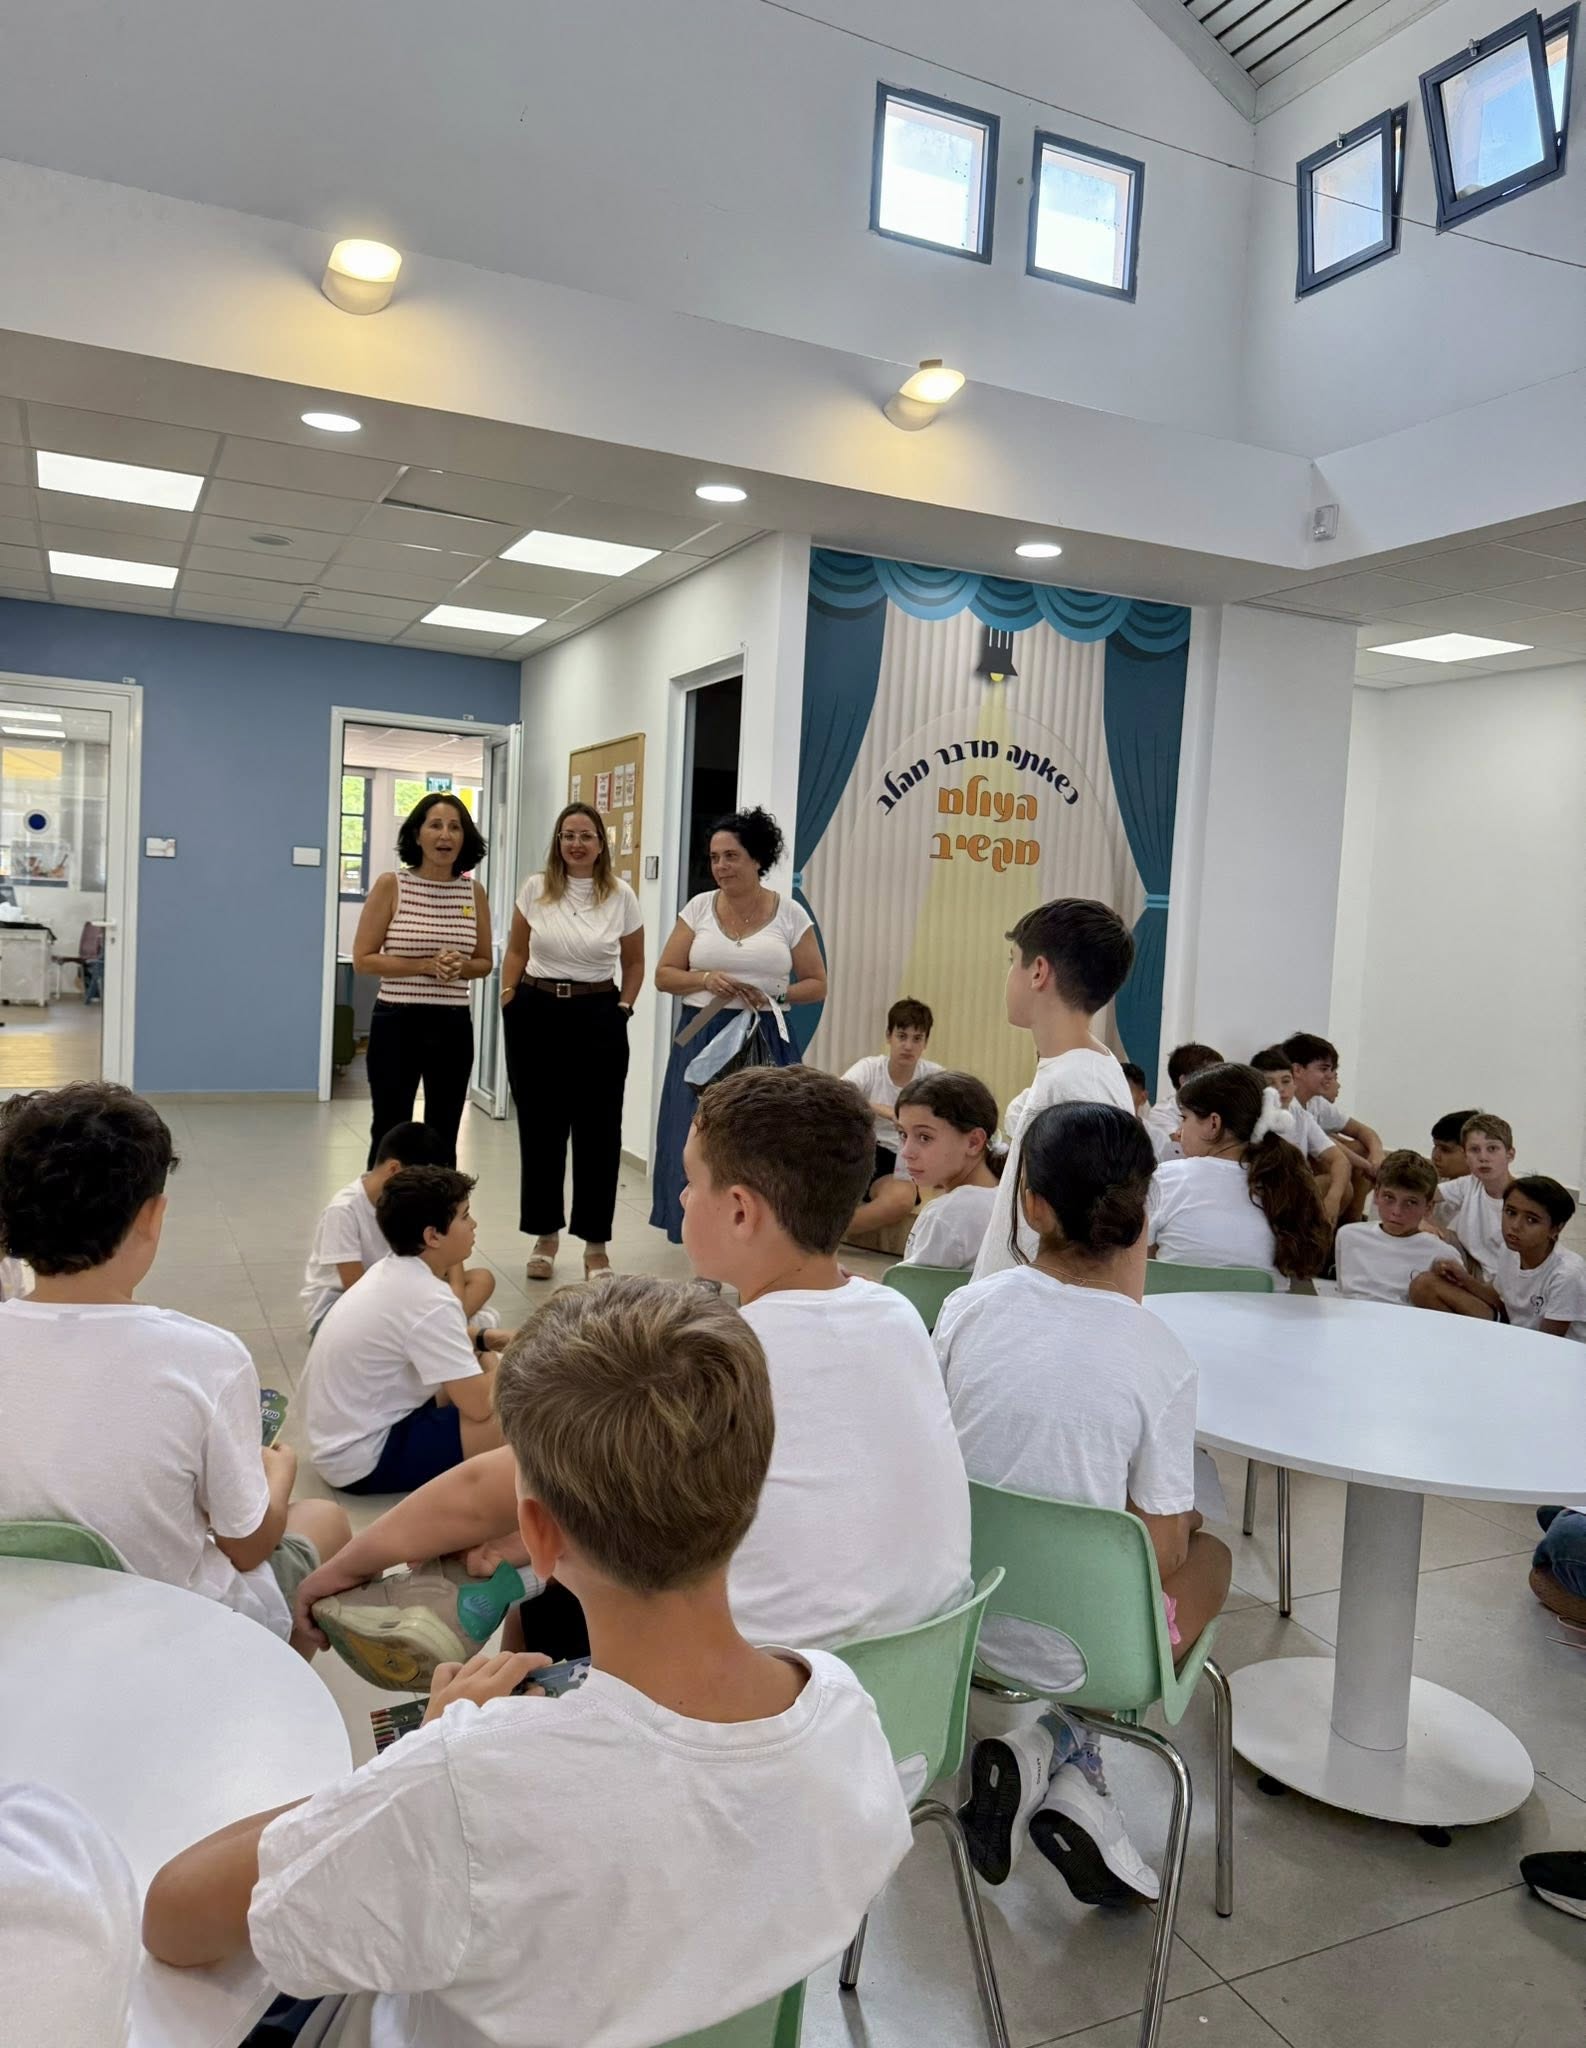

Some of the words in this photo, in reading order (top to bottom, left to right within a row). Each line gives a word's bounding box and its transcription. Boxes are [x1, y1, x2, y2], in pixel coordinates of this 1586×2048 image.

[933, 739, 999, 765] מדבר
[1005, 744, 1079, 805] כשאתה
[876, 758, 930, 816] מהלב
[937, 775, 1038, 823] העולם
[929, 832, 1041, 873] מקשיב
